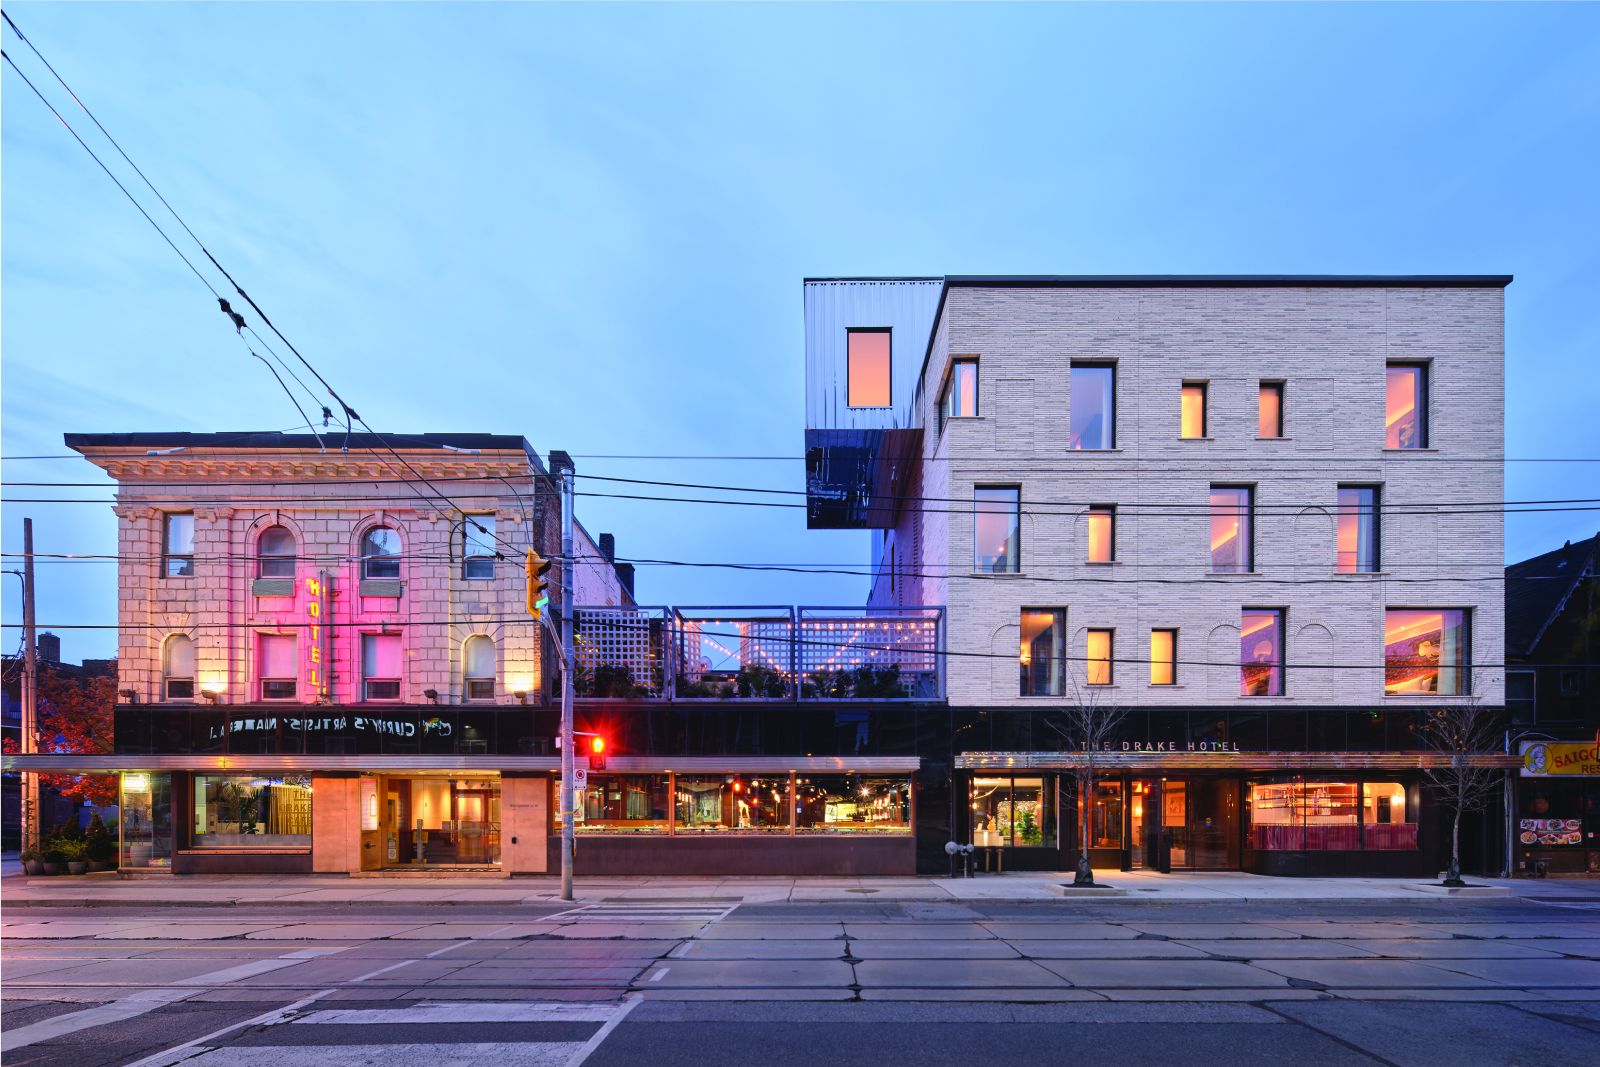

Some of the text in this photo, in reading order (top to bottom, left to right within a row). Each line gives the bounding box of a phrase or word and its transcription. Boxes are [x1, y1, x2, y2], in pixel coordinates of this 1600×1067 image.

[306, 577, 320, 687] HOTEL
[1081, 741, 1240, 751] THE DRAKE HOTEL
[293, 790, 311, 798] THE
